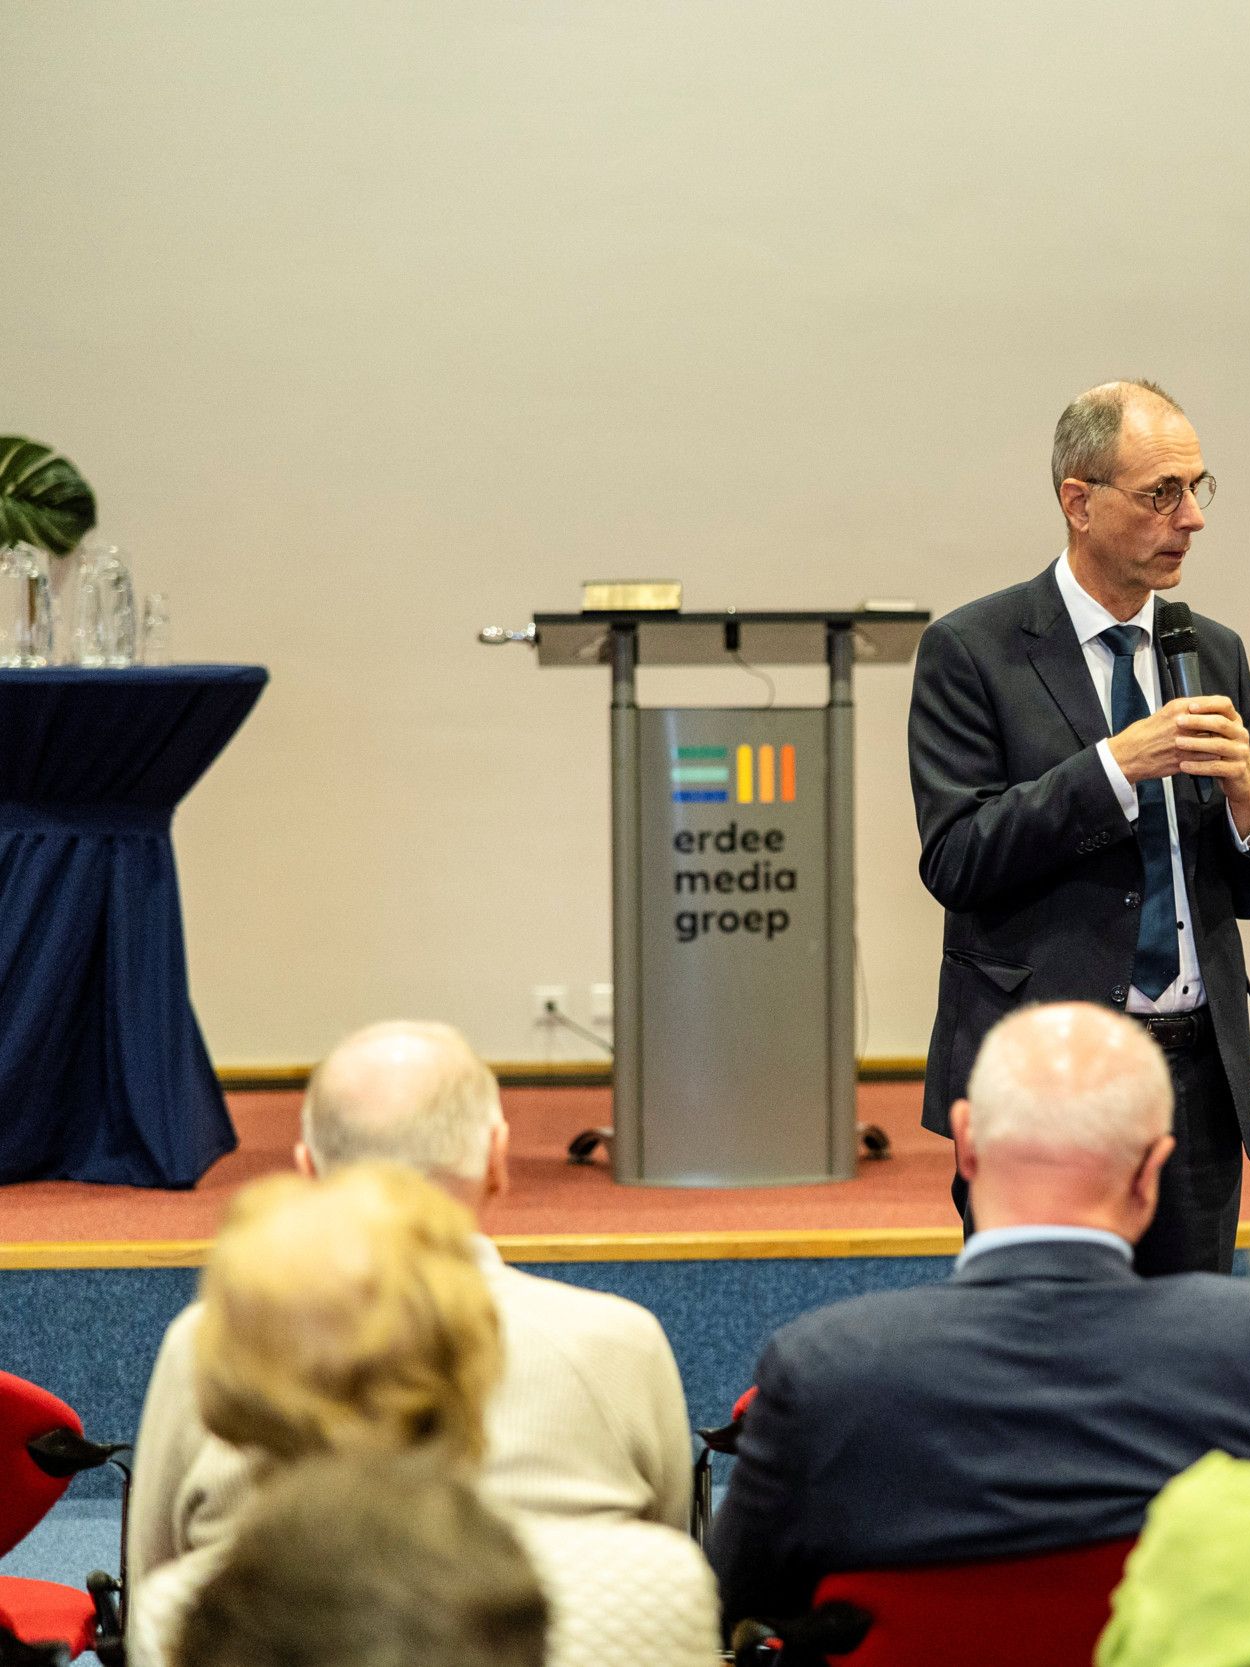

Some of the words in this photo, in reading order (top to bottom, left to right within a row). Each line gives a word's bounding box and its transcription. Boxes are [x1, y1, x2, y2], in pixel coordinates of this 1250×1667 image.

[673, 821, 784, 853] erdee
[675, 862, 796, 893] media
[675, 909, 789, 942] groep
